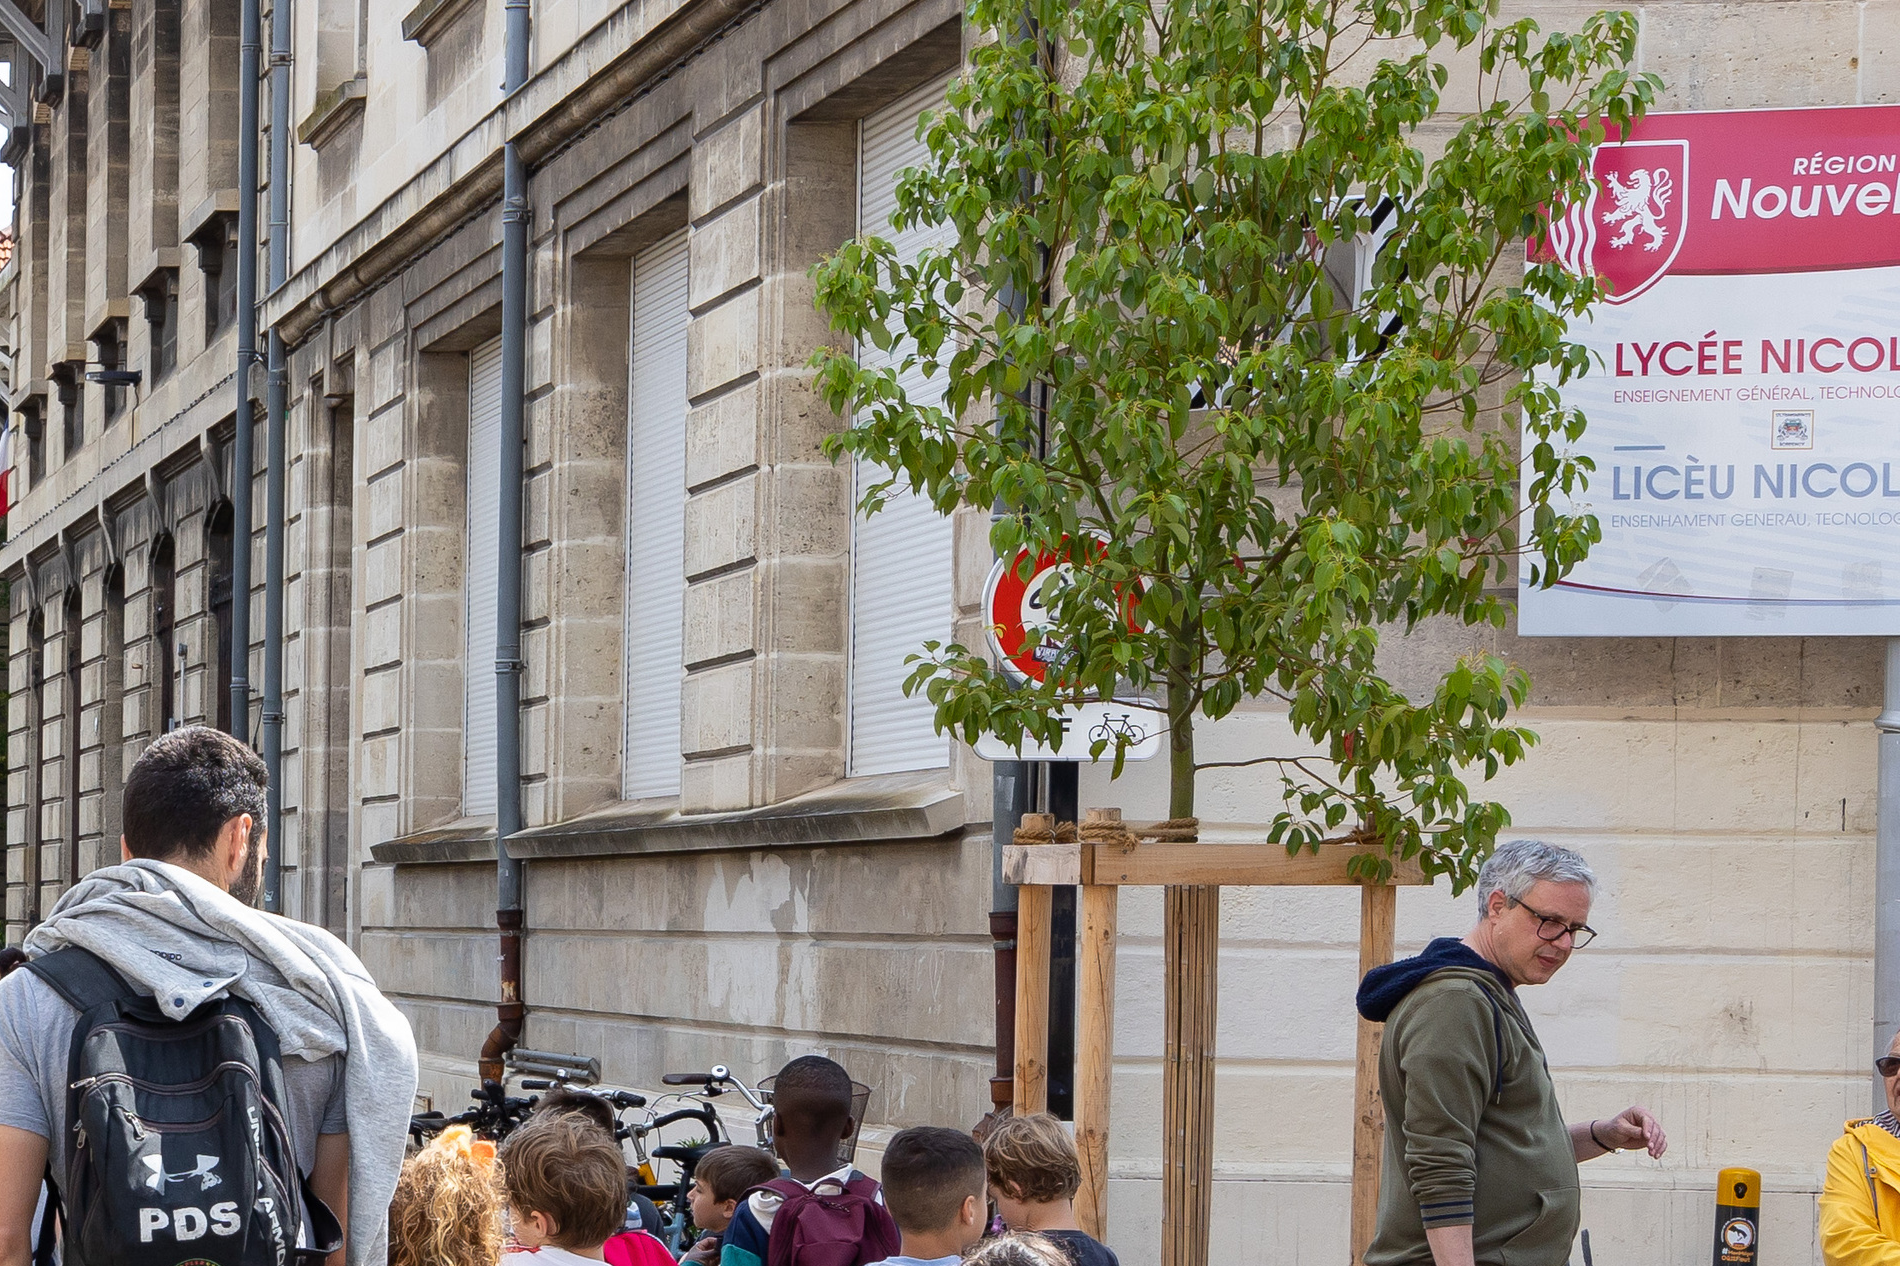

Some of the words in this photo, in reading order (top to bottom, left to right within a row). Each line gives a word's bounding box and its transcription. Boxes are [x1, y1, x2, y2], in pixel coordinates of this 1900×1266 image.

[1793, 152, 1897, 175] RÉGION
[1615, 329, 1743, 377] LYCÉE
[1761, 337, 1900, 374] NICOL
[1614, 387, 1732, 403] ENSEIGNEMENT
[1736, 385, 1815, 401] GÉNÉRAL,
[1612, 454, 1735, 501] LICÈU
[1753, 462, 1900, 499] NICOL
[1611, 514, 1727, 528] ENSENHAMENT
[1730, 513, 1811, 527] GENERAU,
[139, 1201, 241, 1243] PDS
